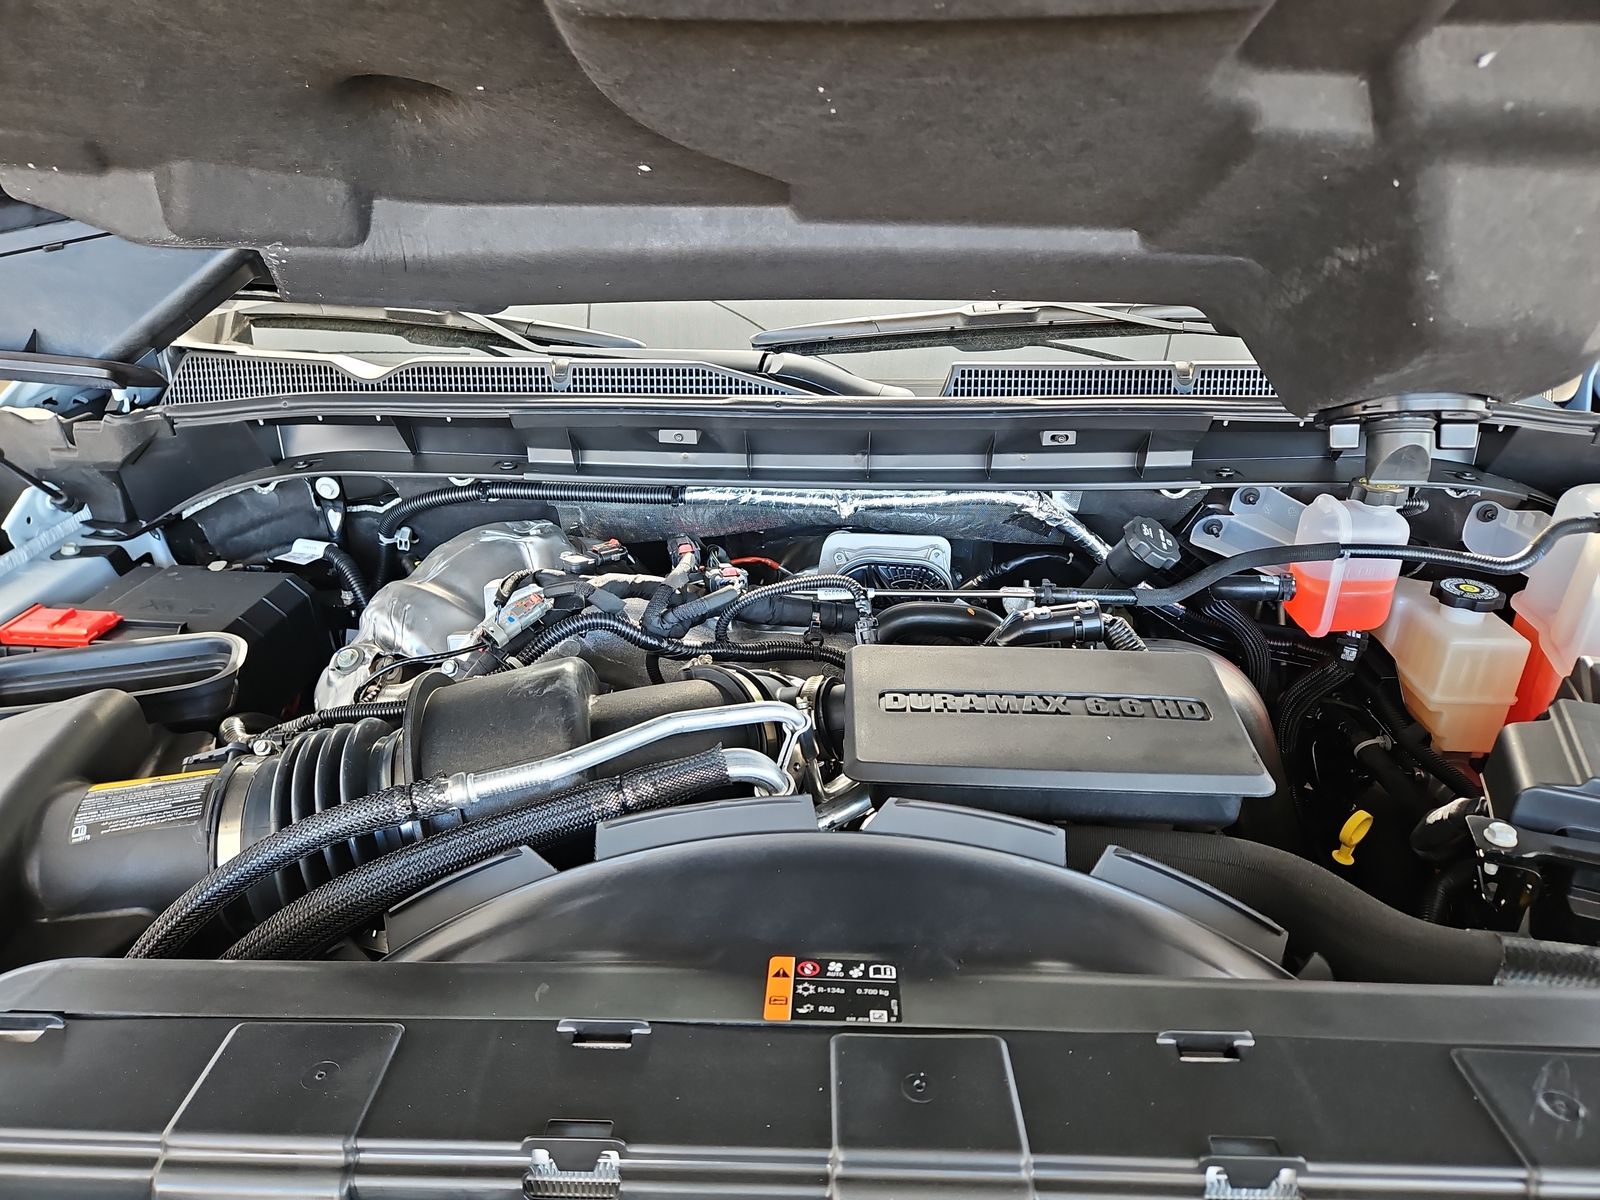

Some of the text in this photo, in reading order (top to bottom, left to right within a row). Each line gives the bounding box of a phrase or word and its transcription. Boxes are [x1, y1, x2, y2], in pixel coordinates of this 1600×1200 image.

[884, 692, 1207, 720] DURAMAX 6.6 HD
[879, 988, 889, 997] kg
[818, 1005, 835, 1013] PAG
